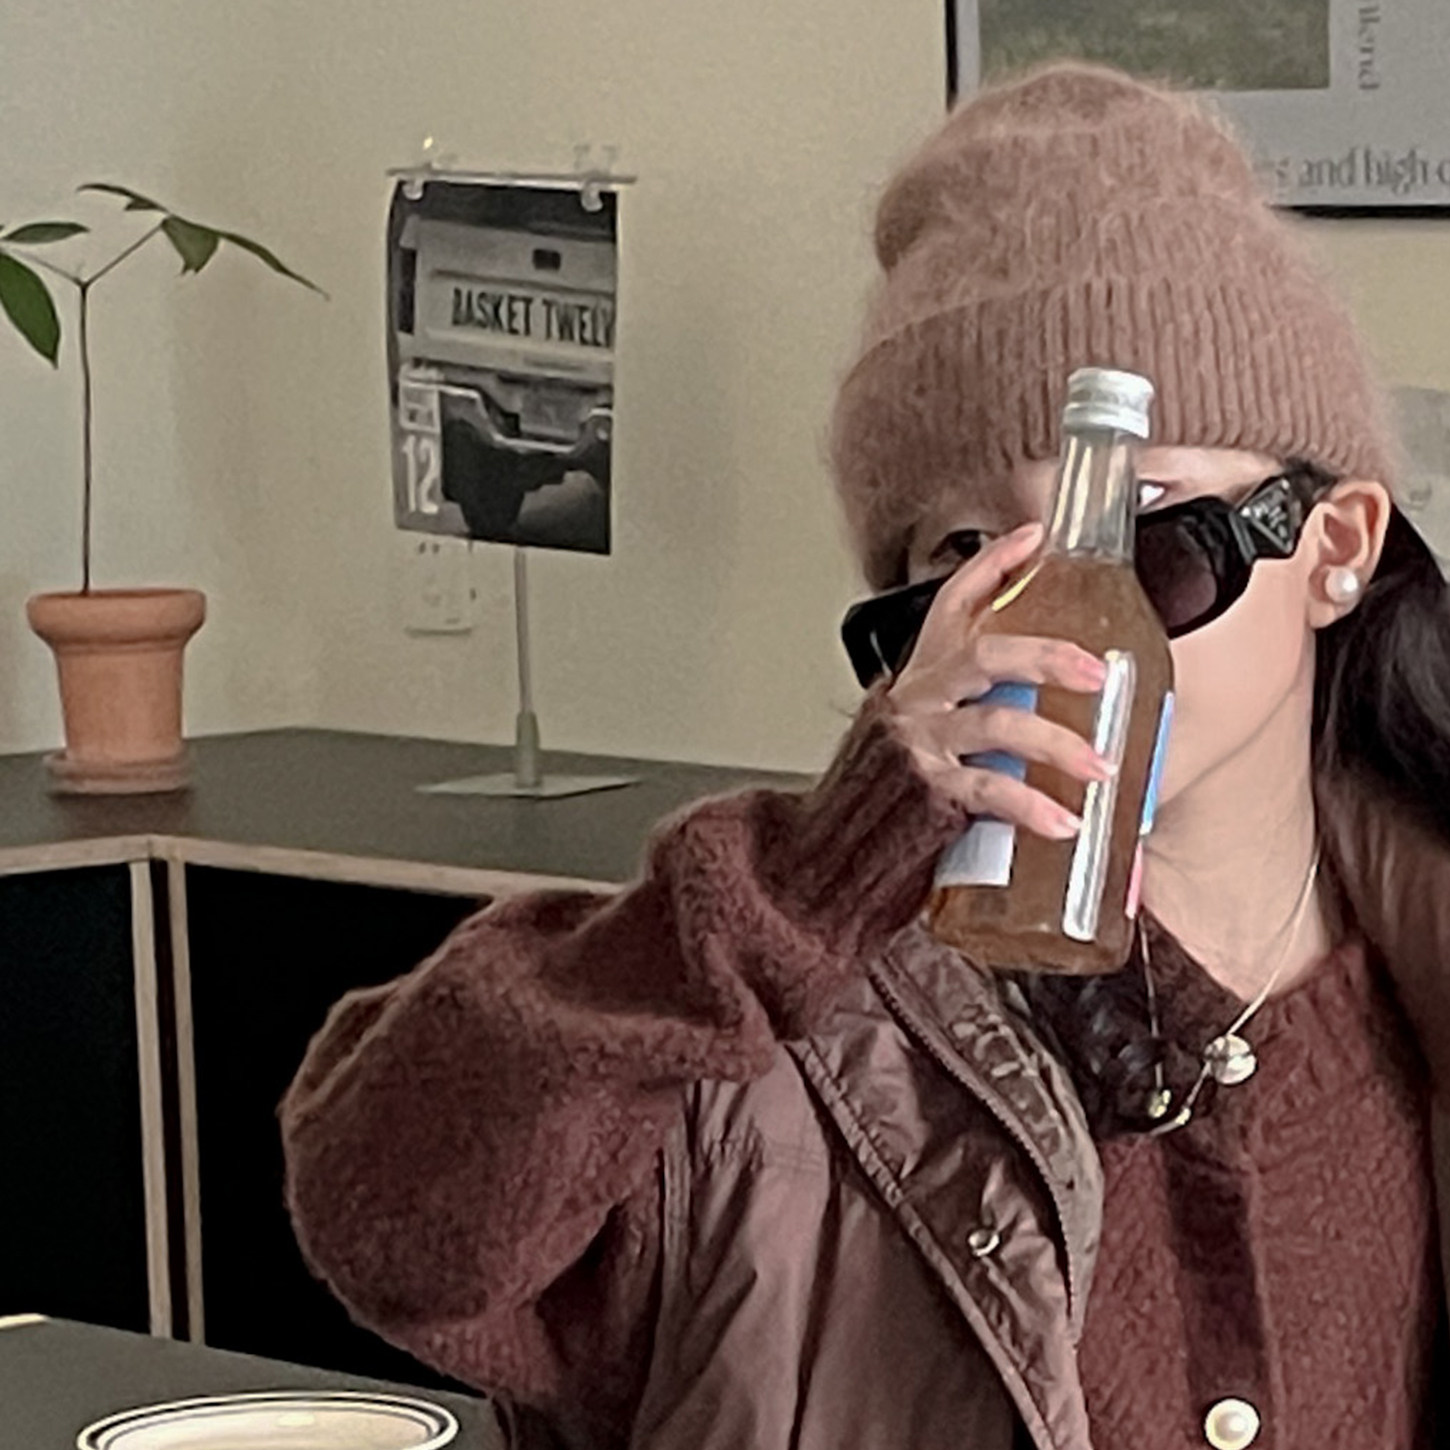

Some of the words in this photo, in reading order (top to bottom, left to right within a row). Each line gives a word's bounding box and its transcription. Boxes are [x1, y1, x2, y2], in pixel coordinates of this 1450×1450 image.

[1299, 146, 1356, 187] and
[1363, 146, 1428, 195] high
[452, 286, 535, 338] BASKET
[402, 434, 441, 515] 12
